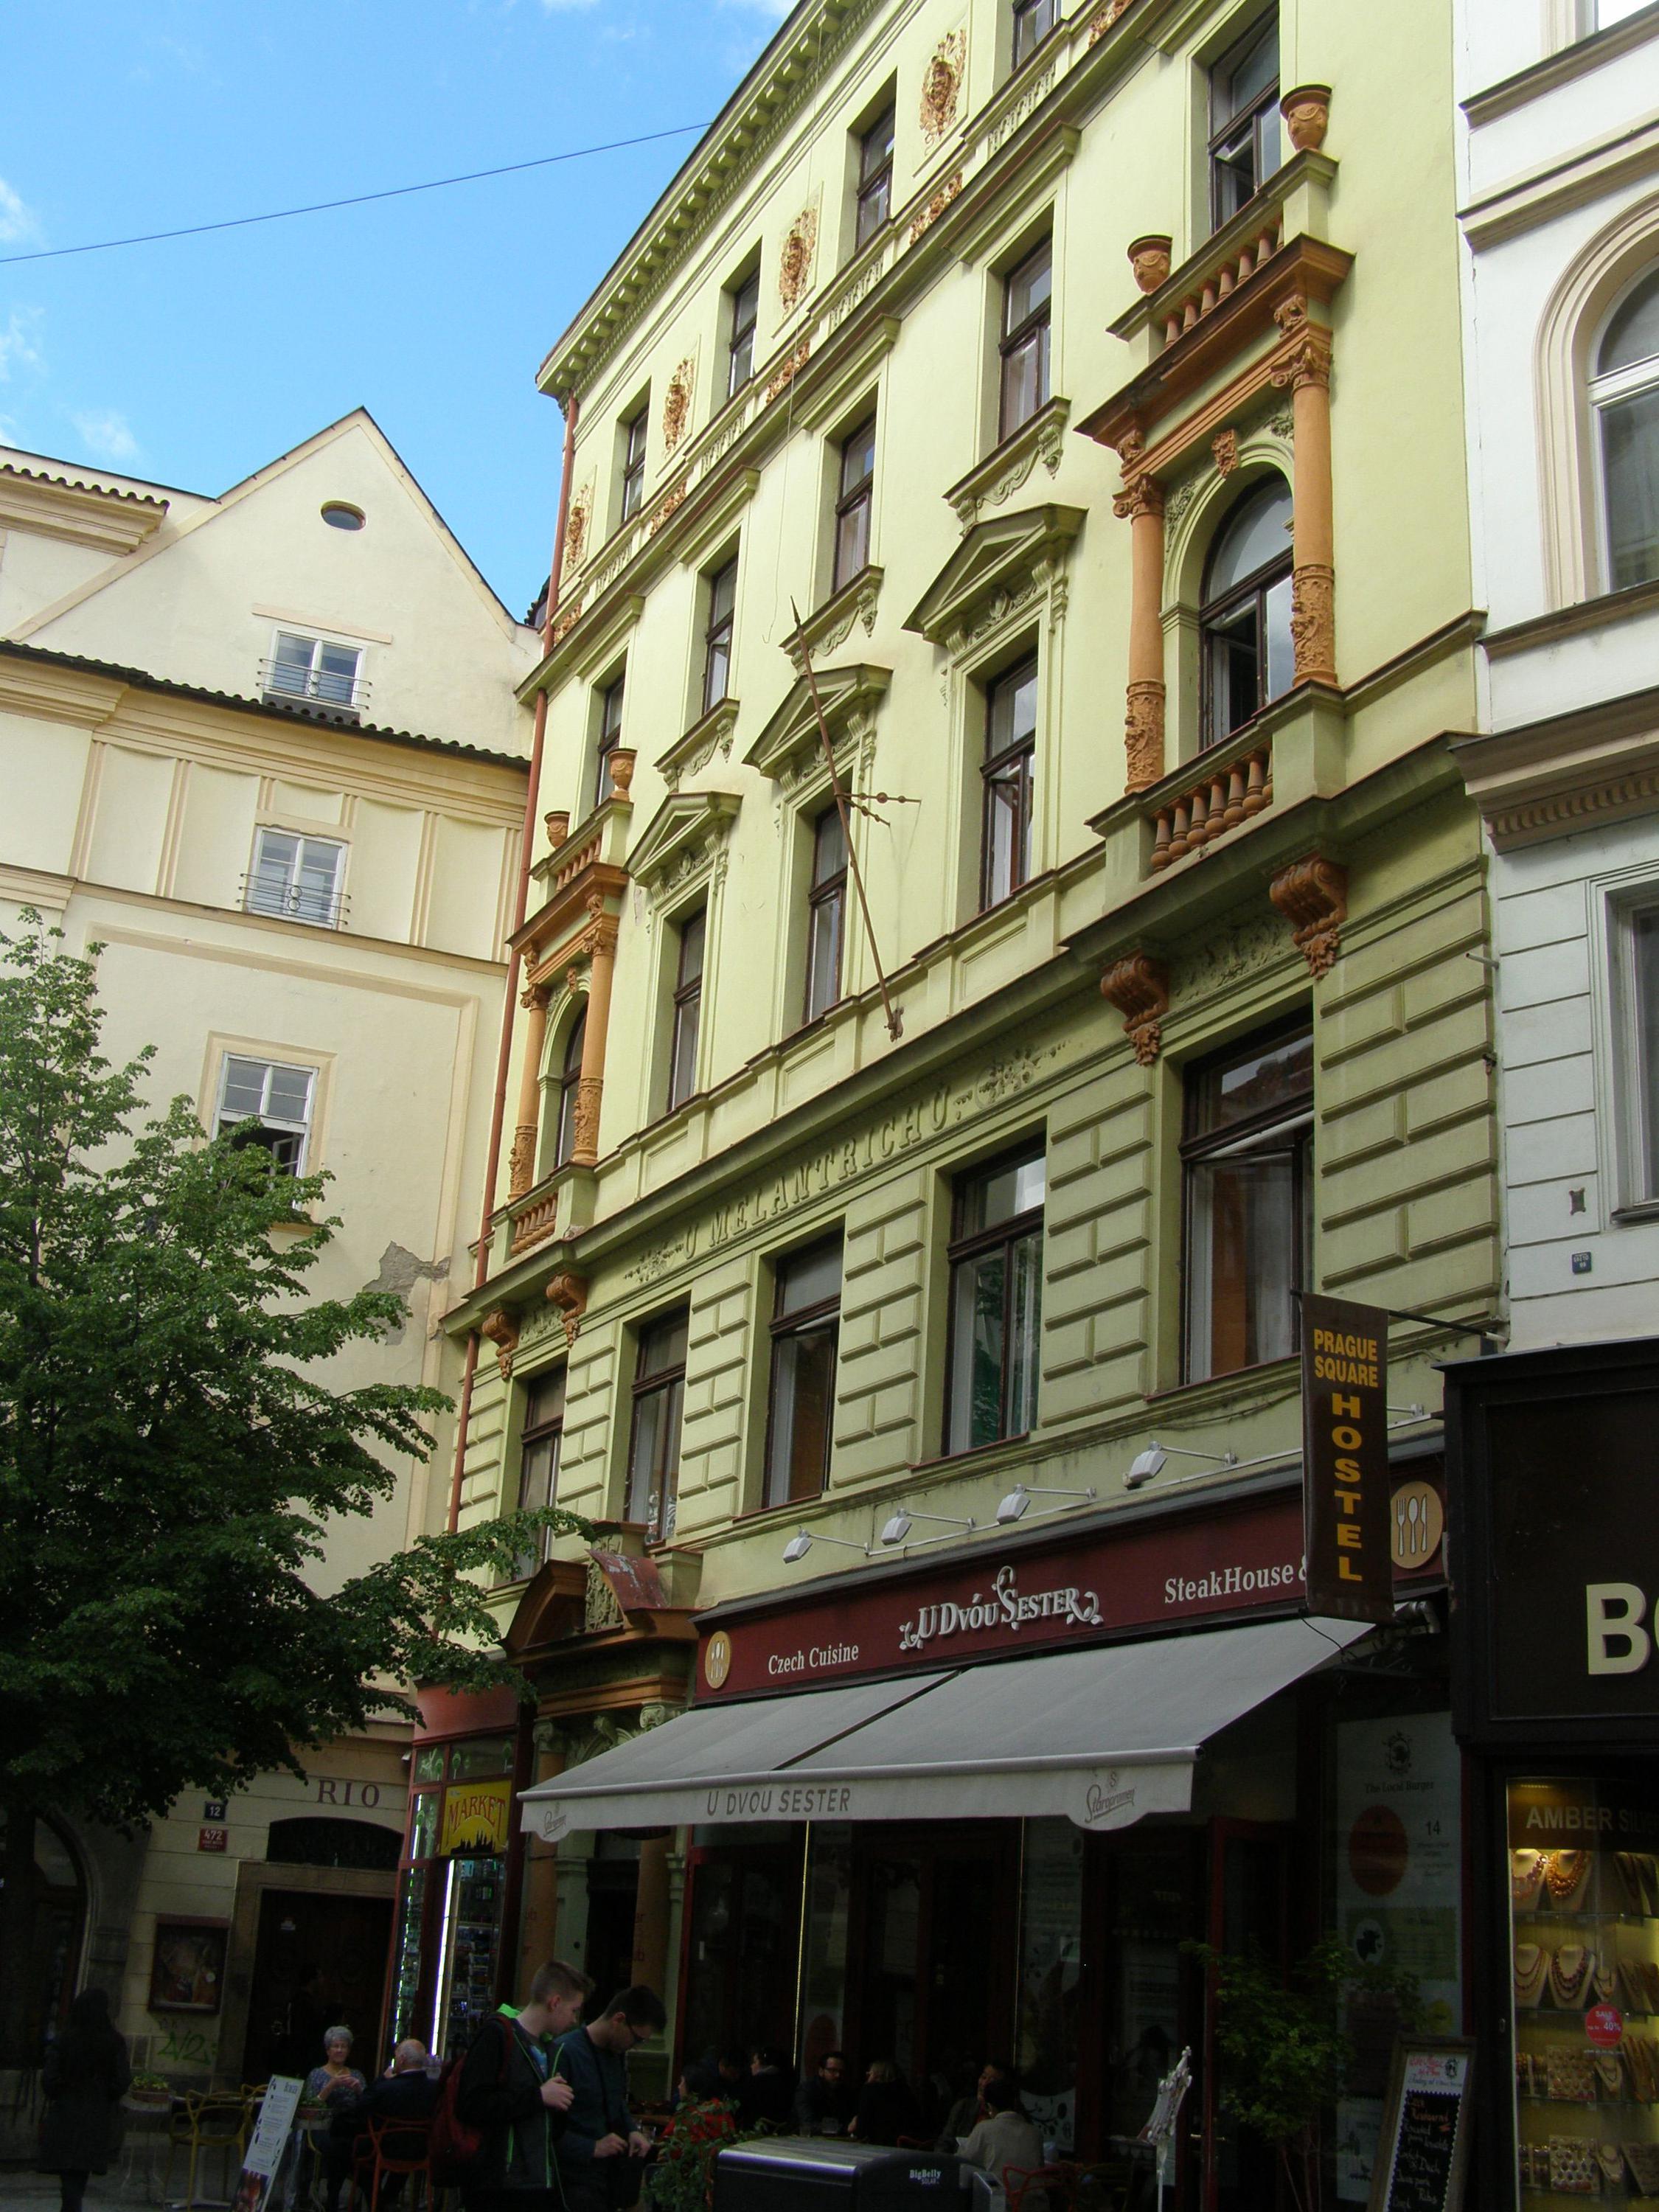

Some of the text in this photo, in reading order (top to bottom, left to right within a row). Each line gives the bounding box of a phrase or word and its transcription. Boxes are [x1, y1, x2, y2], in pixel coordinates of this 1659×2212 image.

[686, 1223, 699, 1260] U
[1314, 1329, 1378, 1362] PRAGUE
[1315, 1355, 1379, 1388] SQUARE
[1332, 1392, 1363, 1582] HOSTEL
[1164, 1562, 1294, 1604] SteakHouse
[1586, 1582, 1659, 1675] B
[768, 1642, 859, 1674] Czech Cuisine
[317, 1779, 380, 1808] RIO
[707, 1787, 851, 1816] U DVOU SESTER
[209, 1805, 221, 1818] 12
[448, 1796, 507, 1838] MARKET
[1526, 1806, 1615, 1831] AMBER
[204, 1829, 223, 1840] 472
[1425, 1820, 1441, 1836] 14
[909, 2168, 942, 2180] BigBelly
